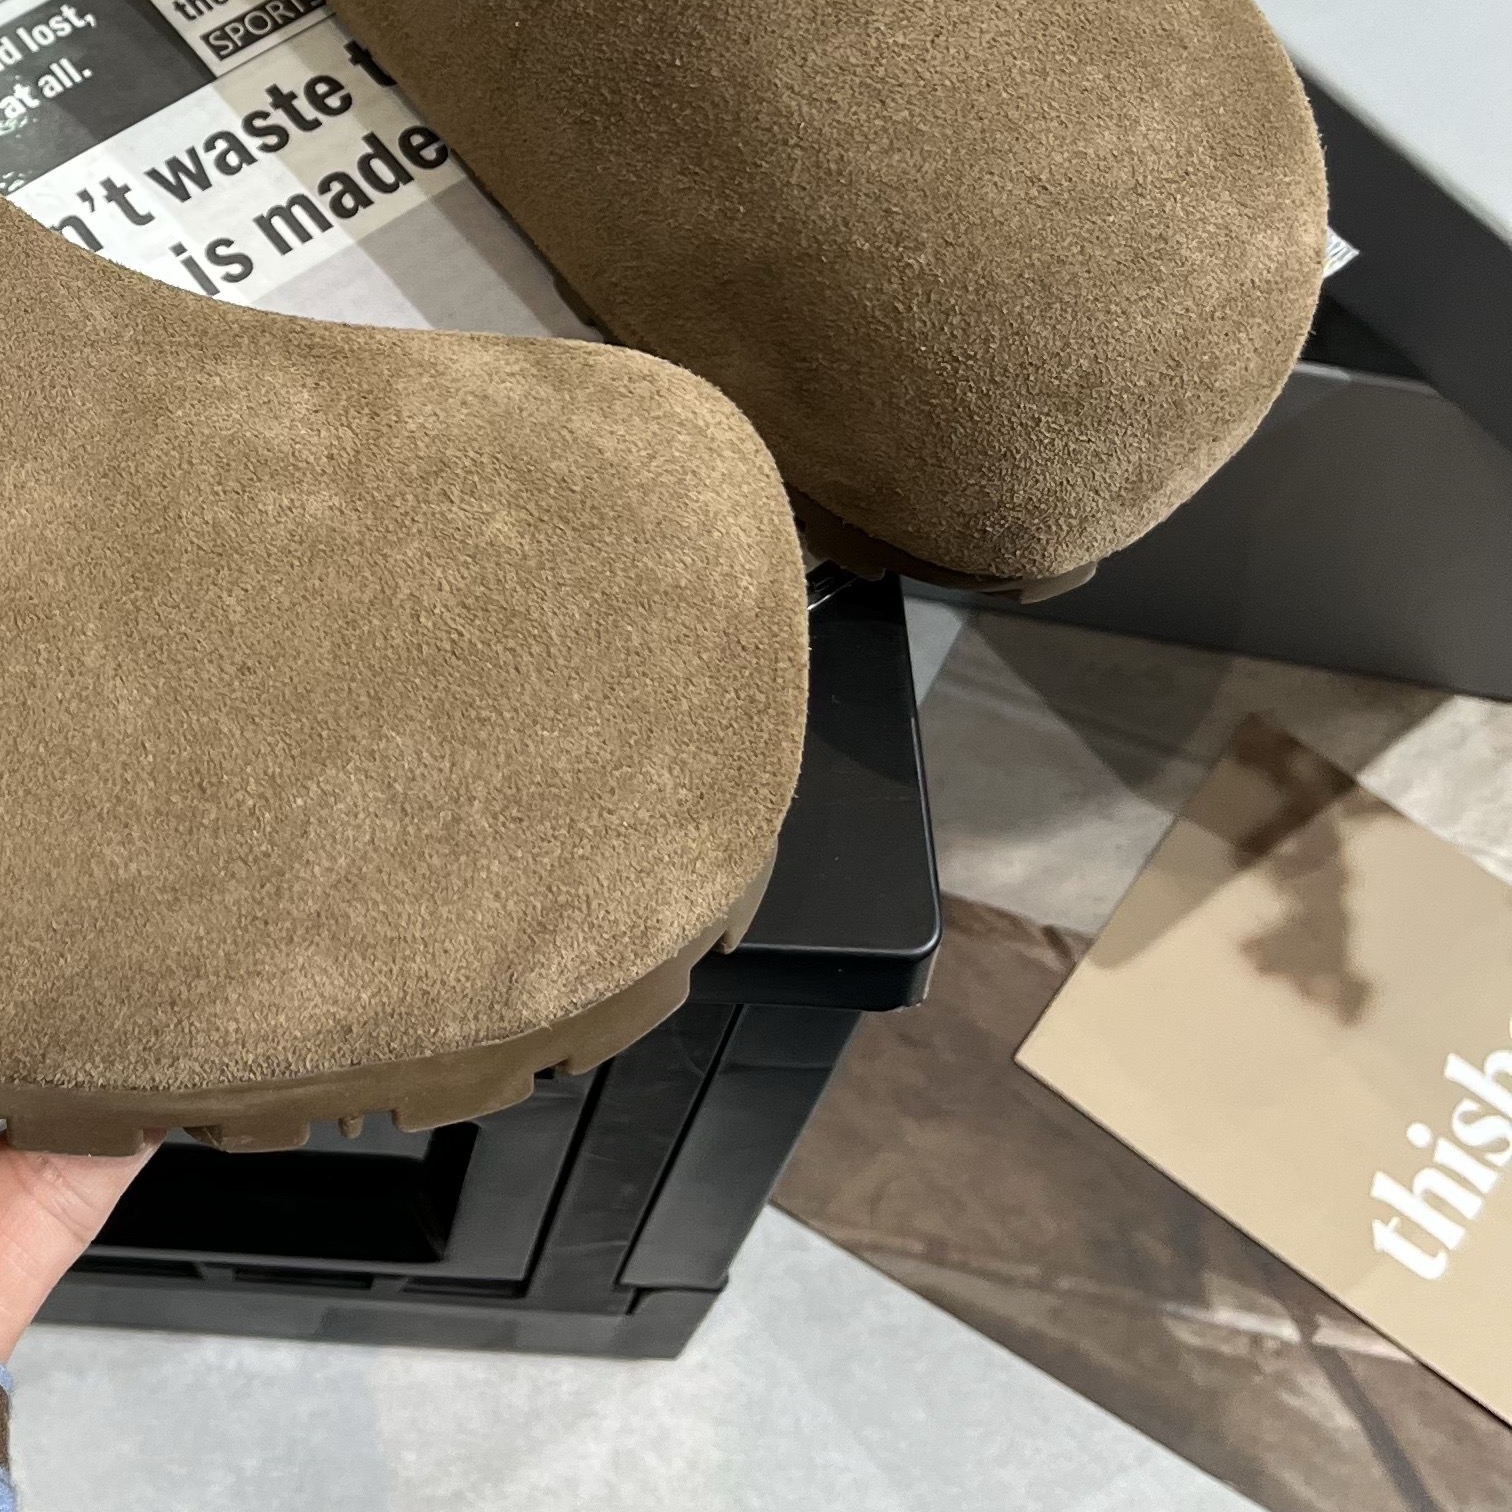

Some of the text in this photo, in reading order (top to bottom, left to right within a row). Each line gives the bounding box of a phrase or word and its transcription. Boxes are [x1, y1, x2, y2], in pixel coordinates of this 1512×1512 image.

[16, 3, 97, 53] lost,
[37, 56, 93, 99] all.
[144, 74, 353, 204] waste
[168, 124, 450, 297] is made
